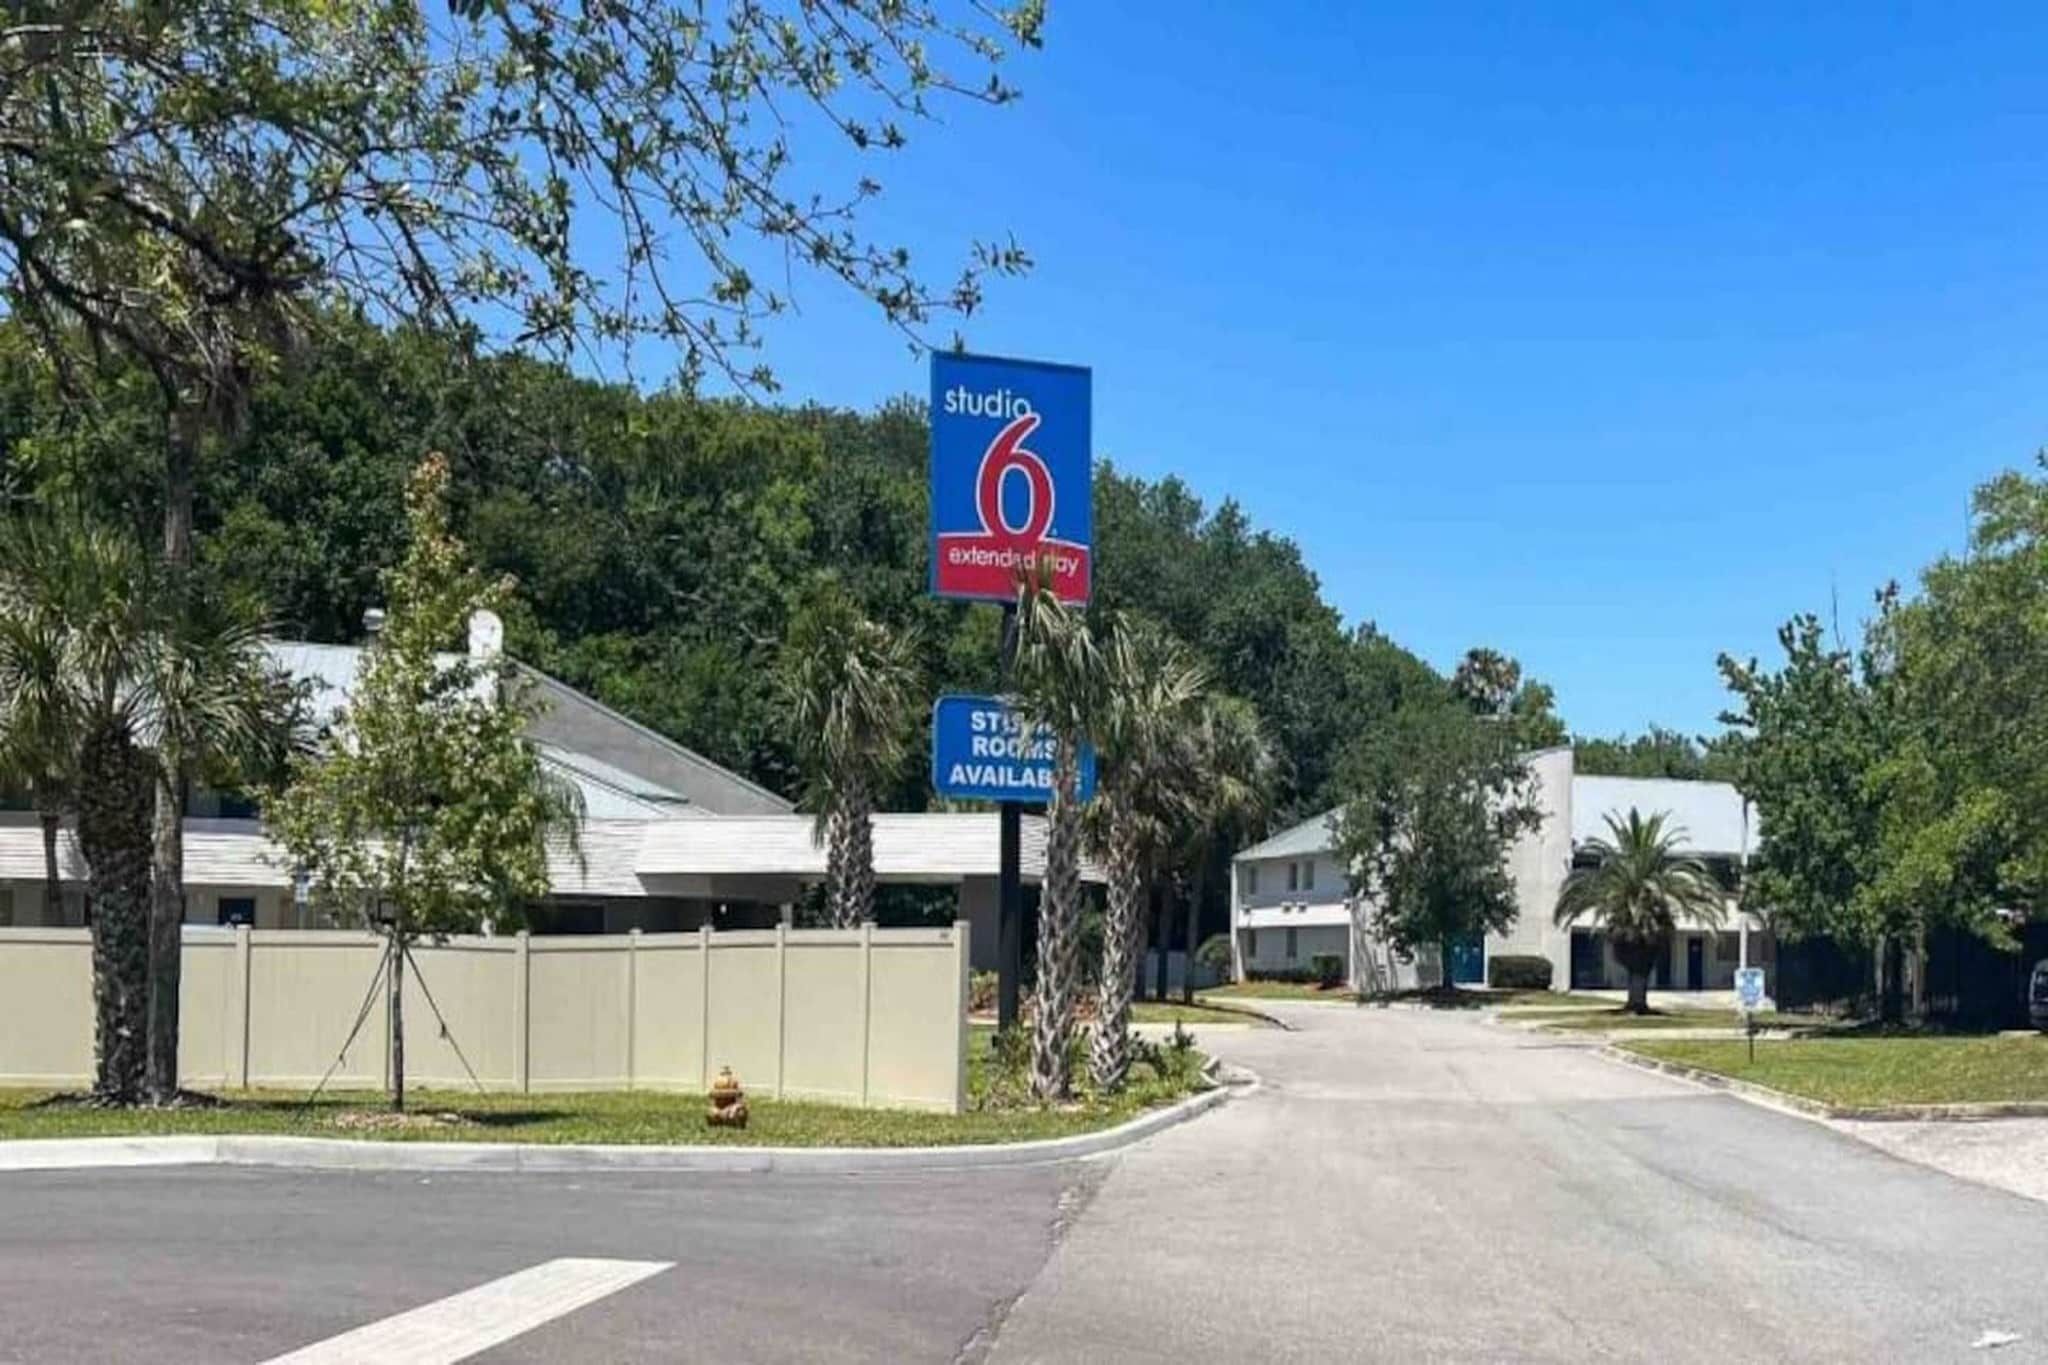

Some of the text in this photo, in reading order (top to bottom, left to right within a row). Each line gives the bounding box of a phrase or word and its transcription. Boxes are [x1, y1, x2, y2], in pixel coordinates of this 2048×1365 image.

[944, 384, 1032, 419] studio
[976, 412, 1056, 537] 6
[950, 764, 1082, 790] AVAILAB
